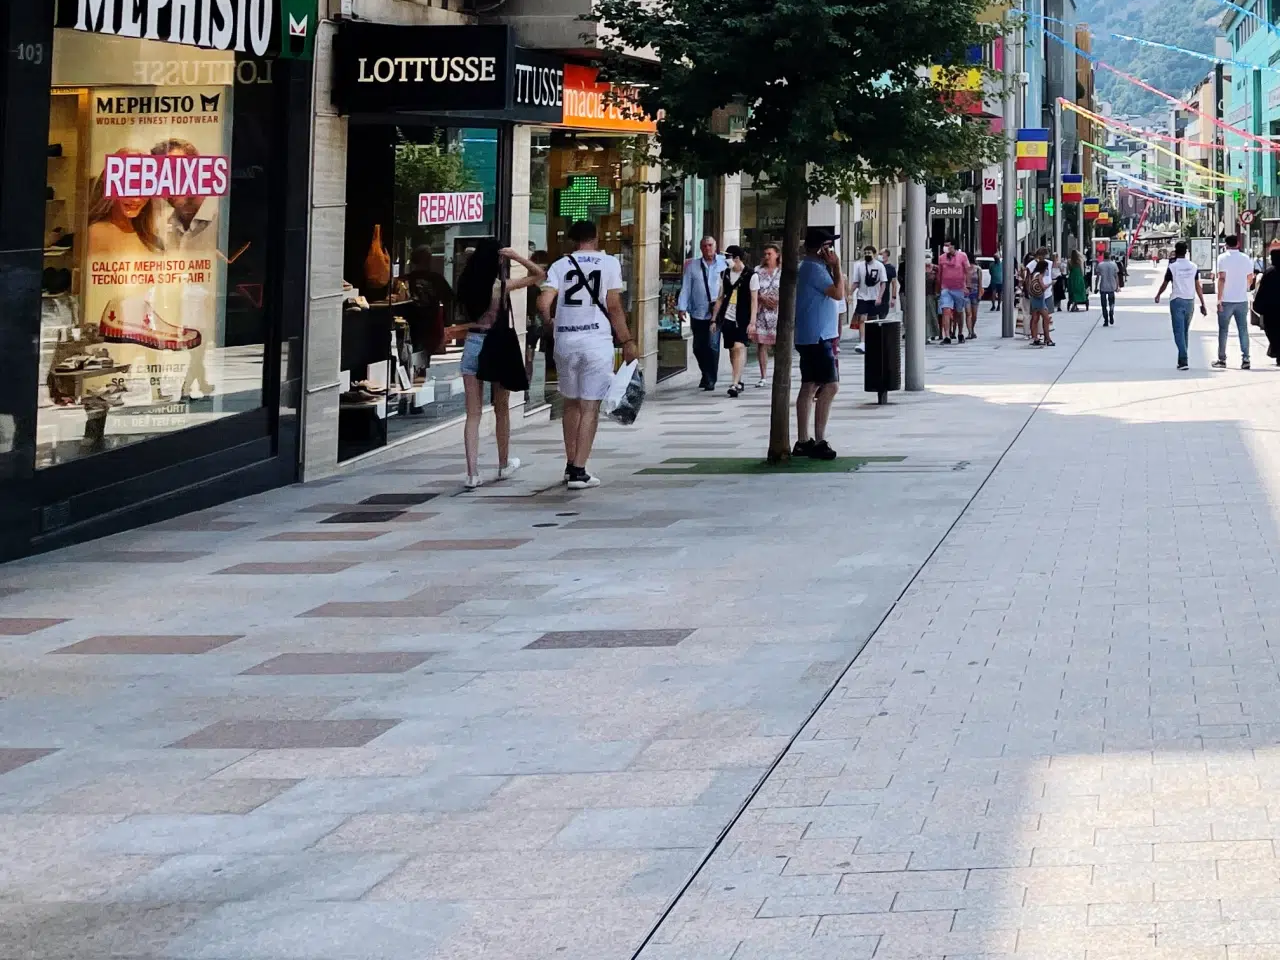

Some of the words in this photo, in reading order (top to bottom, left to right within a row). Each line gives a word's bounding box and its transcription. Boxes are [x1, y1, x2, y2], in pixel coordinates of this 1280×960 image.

[17, 43, 43, 65] 103
[358, 57, 496, 82] LOTTUSSE
[515, 64, 563, 107] TTUSSE
[96, 95, 194, 114] MEPHISTO
[564, 81, 605, 119] màcia
[96, 116, 136, 126] WORLD'S
[139, 116, 168, 125] FINEST
[171, 115, 219, 124] FOOTWEAR
[105, 156, 228, 197] REBAIXES
[419, 193, 483, 223] REBAIXES
[930, 207, 963, 215] Bershka
[92, 261, 131, 276] CALÇAT
[133, 259, 185, 271] MEPHISTO
[188, 259, 211, 270] AMB
[92, 273, 154, 285] TECNOLOGIA
[564, 269, 602, 307] 21
